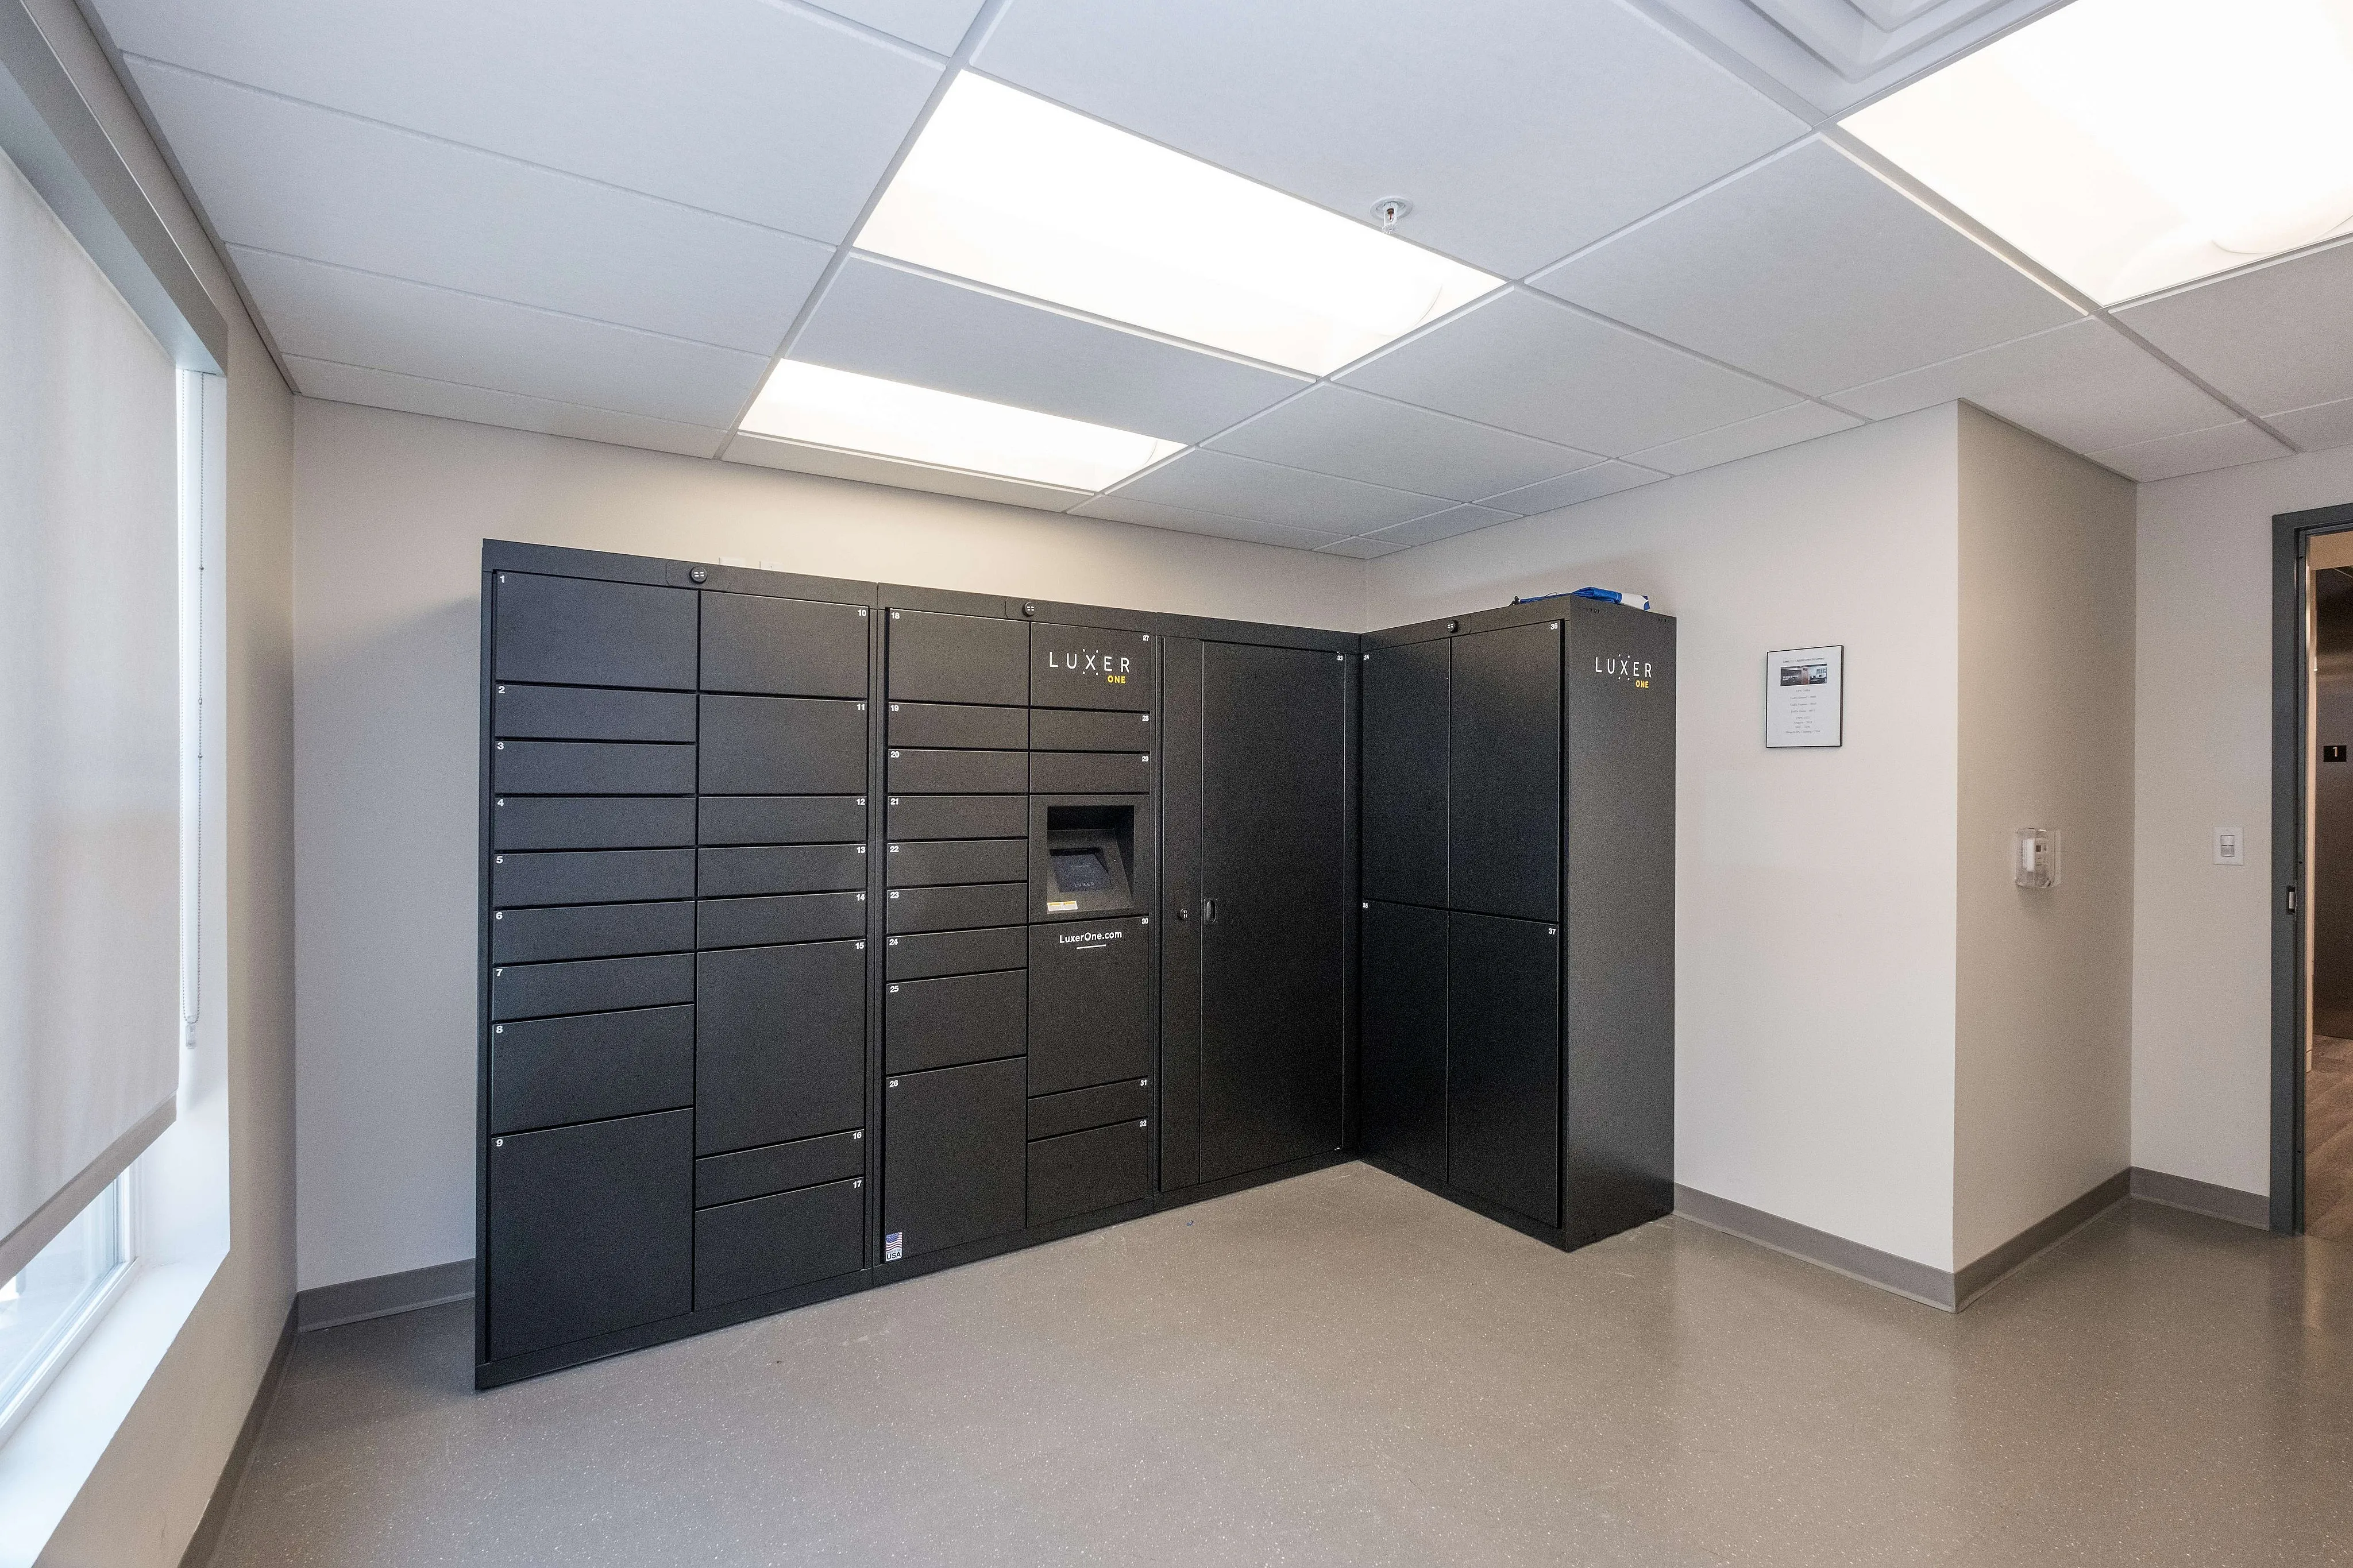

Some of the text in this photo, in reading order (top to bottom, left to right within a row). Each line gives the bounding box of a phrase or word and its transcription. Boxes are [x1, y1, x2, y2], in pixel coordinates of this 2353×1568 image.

[499, 575, 505, 584] 1
[858, 609, 867, 617] 10
[891, 612, 900, 620] 18
[1049, 650, 1131, 675] LUXER
[1595, 655, 1652, 679] LUXER
[1107, 674, 1127, 684] ONE
[1635, 680, 1649, 689] ONE
[498, 685, 506, 694] 2
[497, 741, 504, 750] 3
[2332, 747, 2337, 757] 1
[497, 798, 504, 807] 4
[856, 798, 866, 806] 12
[496, 855, 503, 864] 5
[856, 893, 865, 901] 14
[495, 912, 503, 920] 6
[1059, 930, 1123, 944] LuxerOne.com
[855, 941, 865, 949] 15
[889, 938, 898, 946] 24
[496, 968, 503, 977] 7
[889, 985, 899, 993] 25
[496, 1025, 503, 1034] 8
[889, 1079, 898, 1088] 26
[1140, 1079, 1147, 1087] 31
[1139, 1119, 1147, 1127] 32
[853, 1131, 862, 1140] 16
[496, 1138, 503, 1147] 9
[853, 1180, 862, 1188] 17
[886, 1251, 901, 1260] USA
